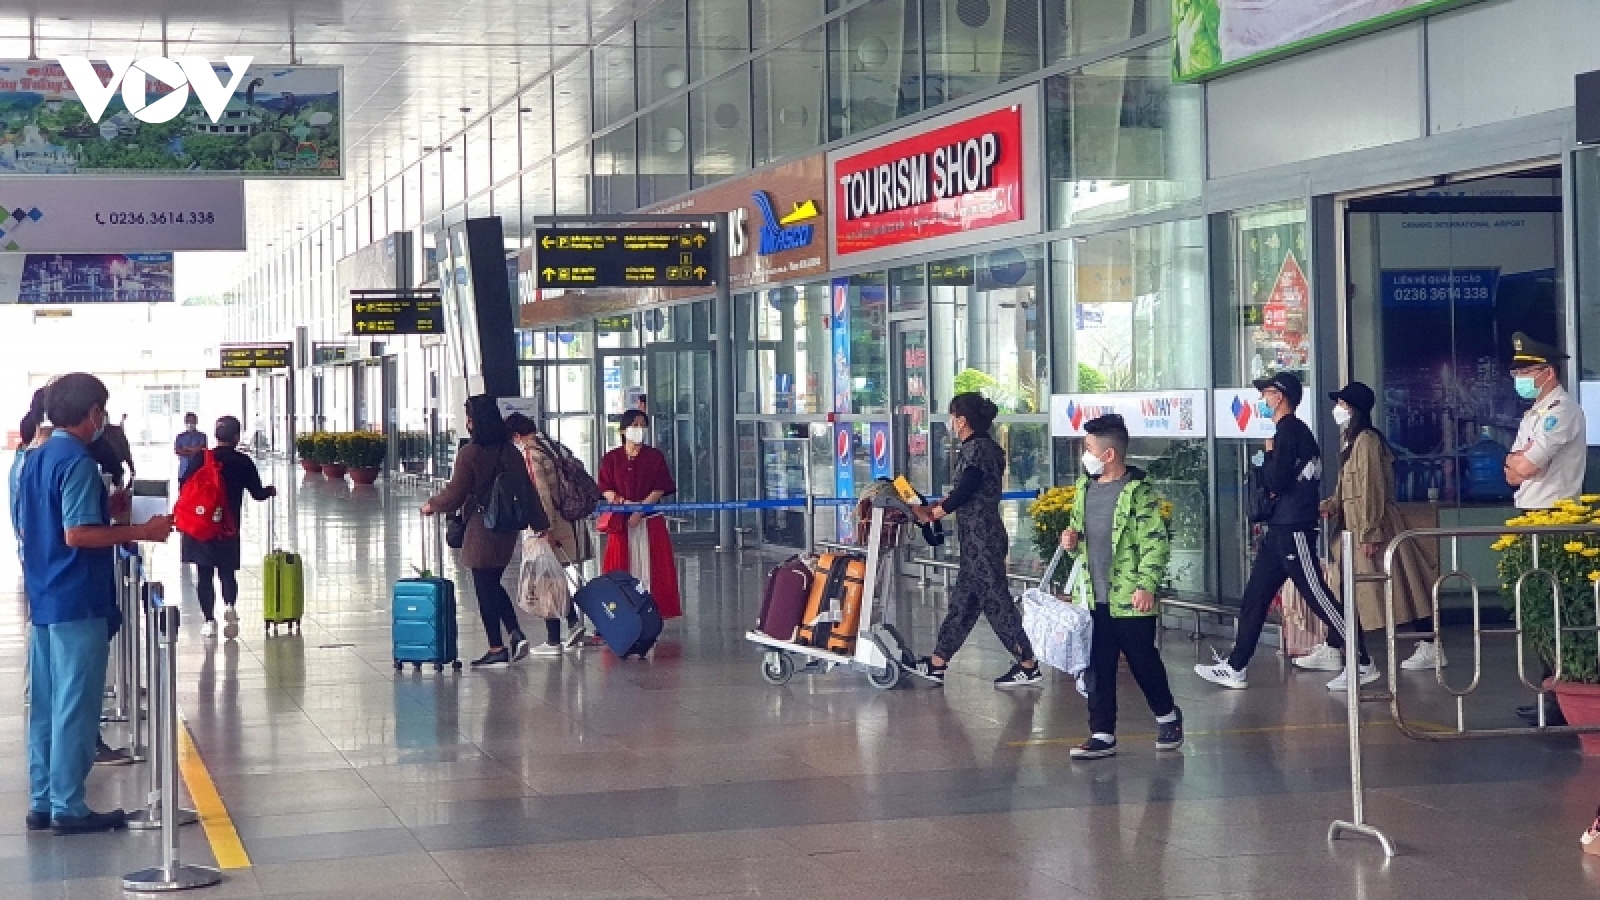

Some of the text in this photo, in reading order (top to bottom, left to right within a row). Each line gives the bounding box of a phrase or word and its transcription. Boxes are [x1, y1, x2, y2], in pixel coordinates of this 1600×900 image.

[840, 152, 927, 221] TOURISM
[933, 133, 996, 199] SHOP
[109, 211, 215, 225] 0236.3614.338
[1463, 286, 1490, 300] 338
